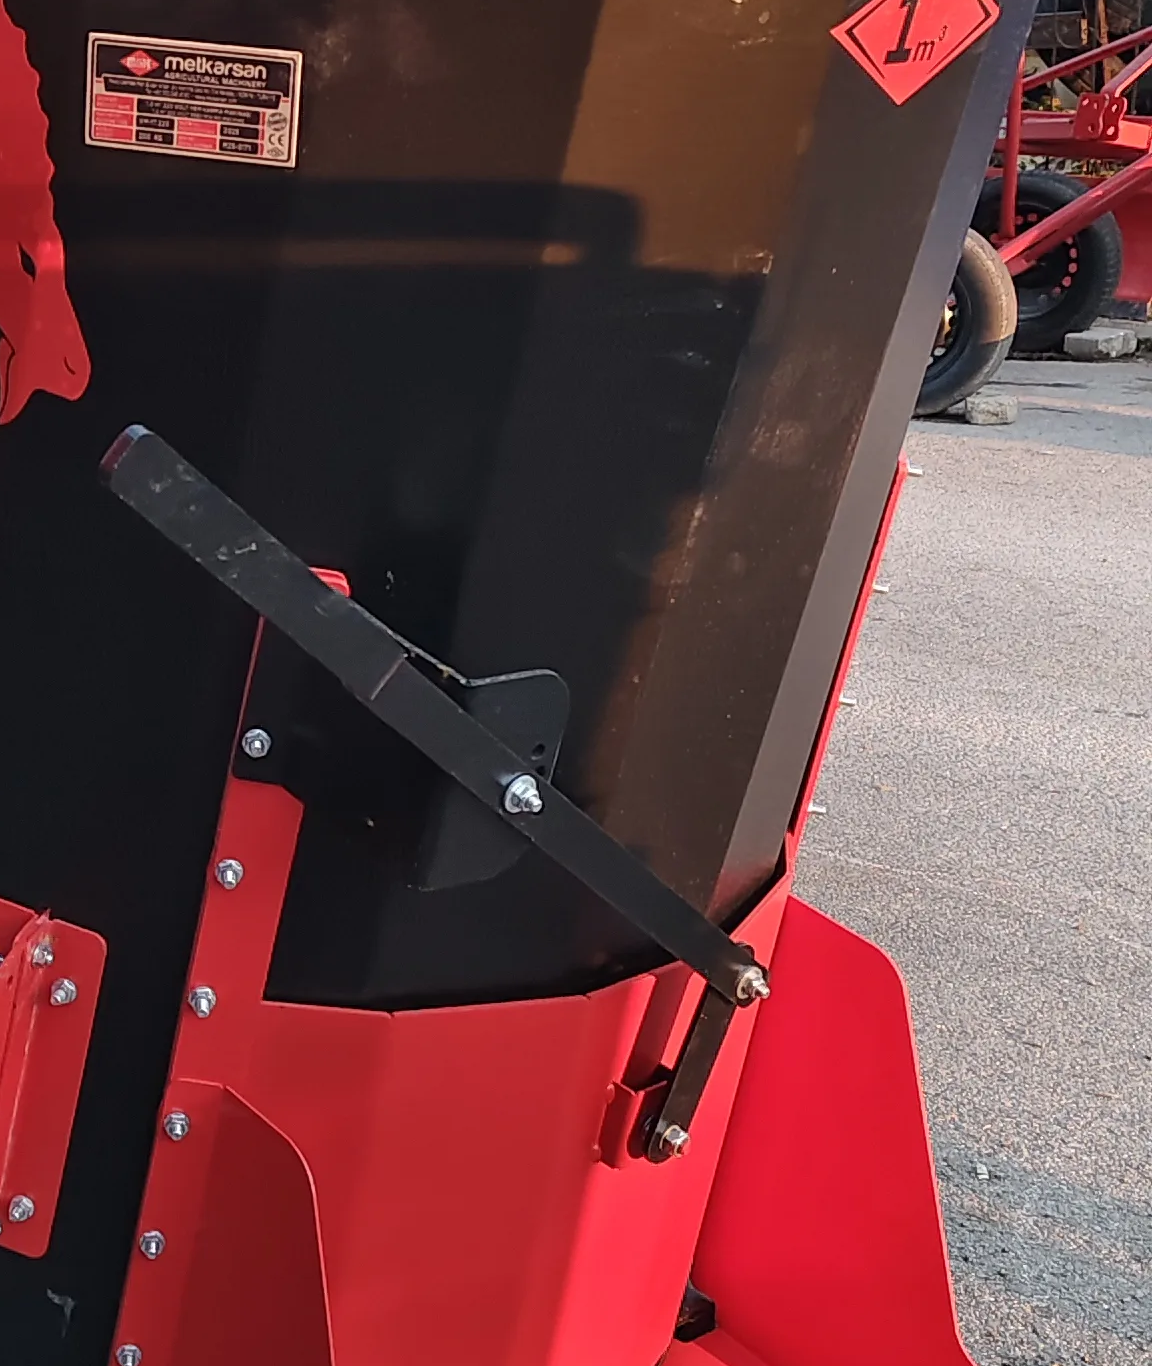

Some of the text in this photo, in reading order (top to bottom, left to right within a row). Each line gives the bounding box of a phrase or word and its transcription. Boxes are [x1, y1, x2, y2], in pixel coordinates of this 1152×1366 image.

[164, 55, 267, 80] melkarsan
[164, 72, 267, 88] AGRICULTURAL MACHINERY
